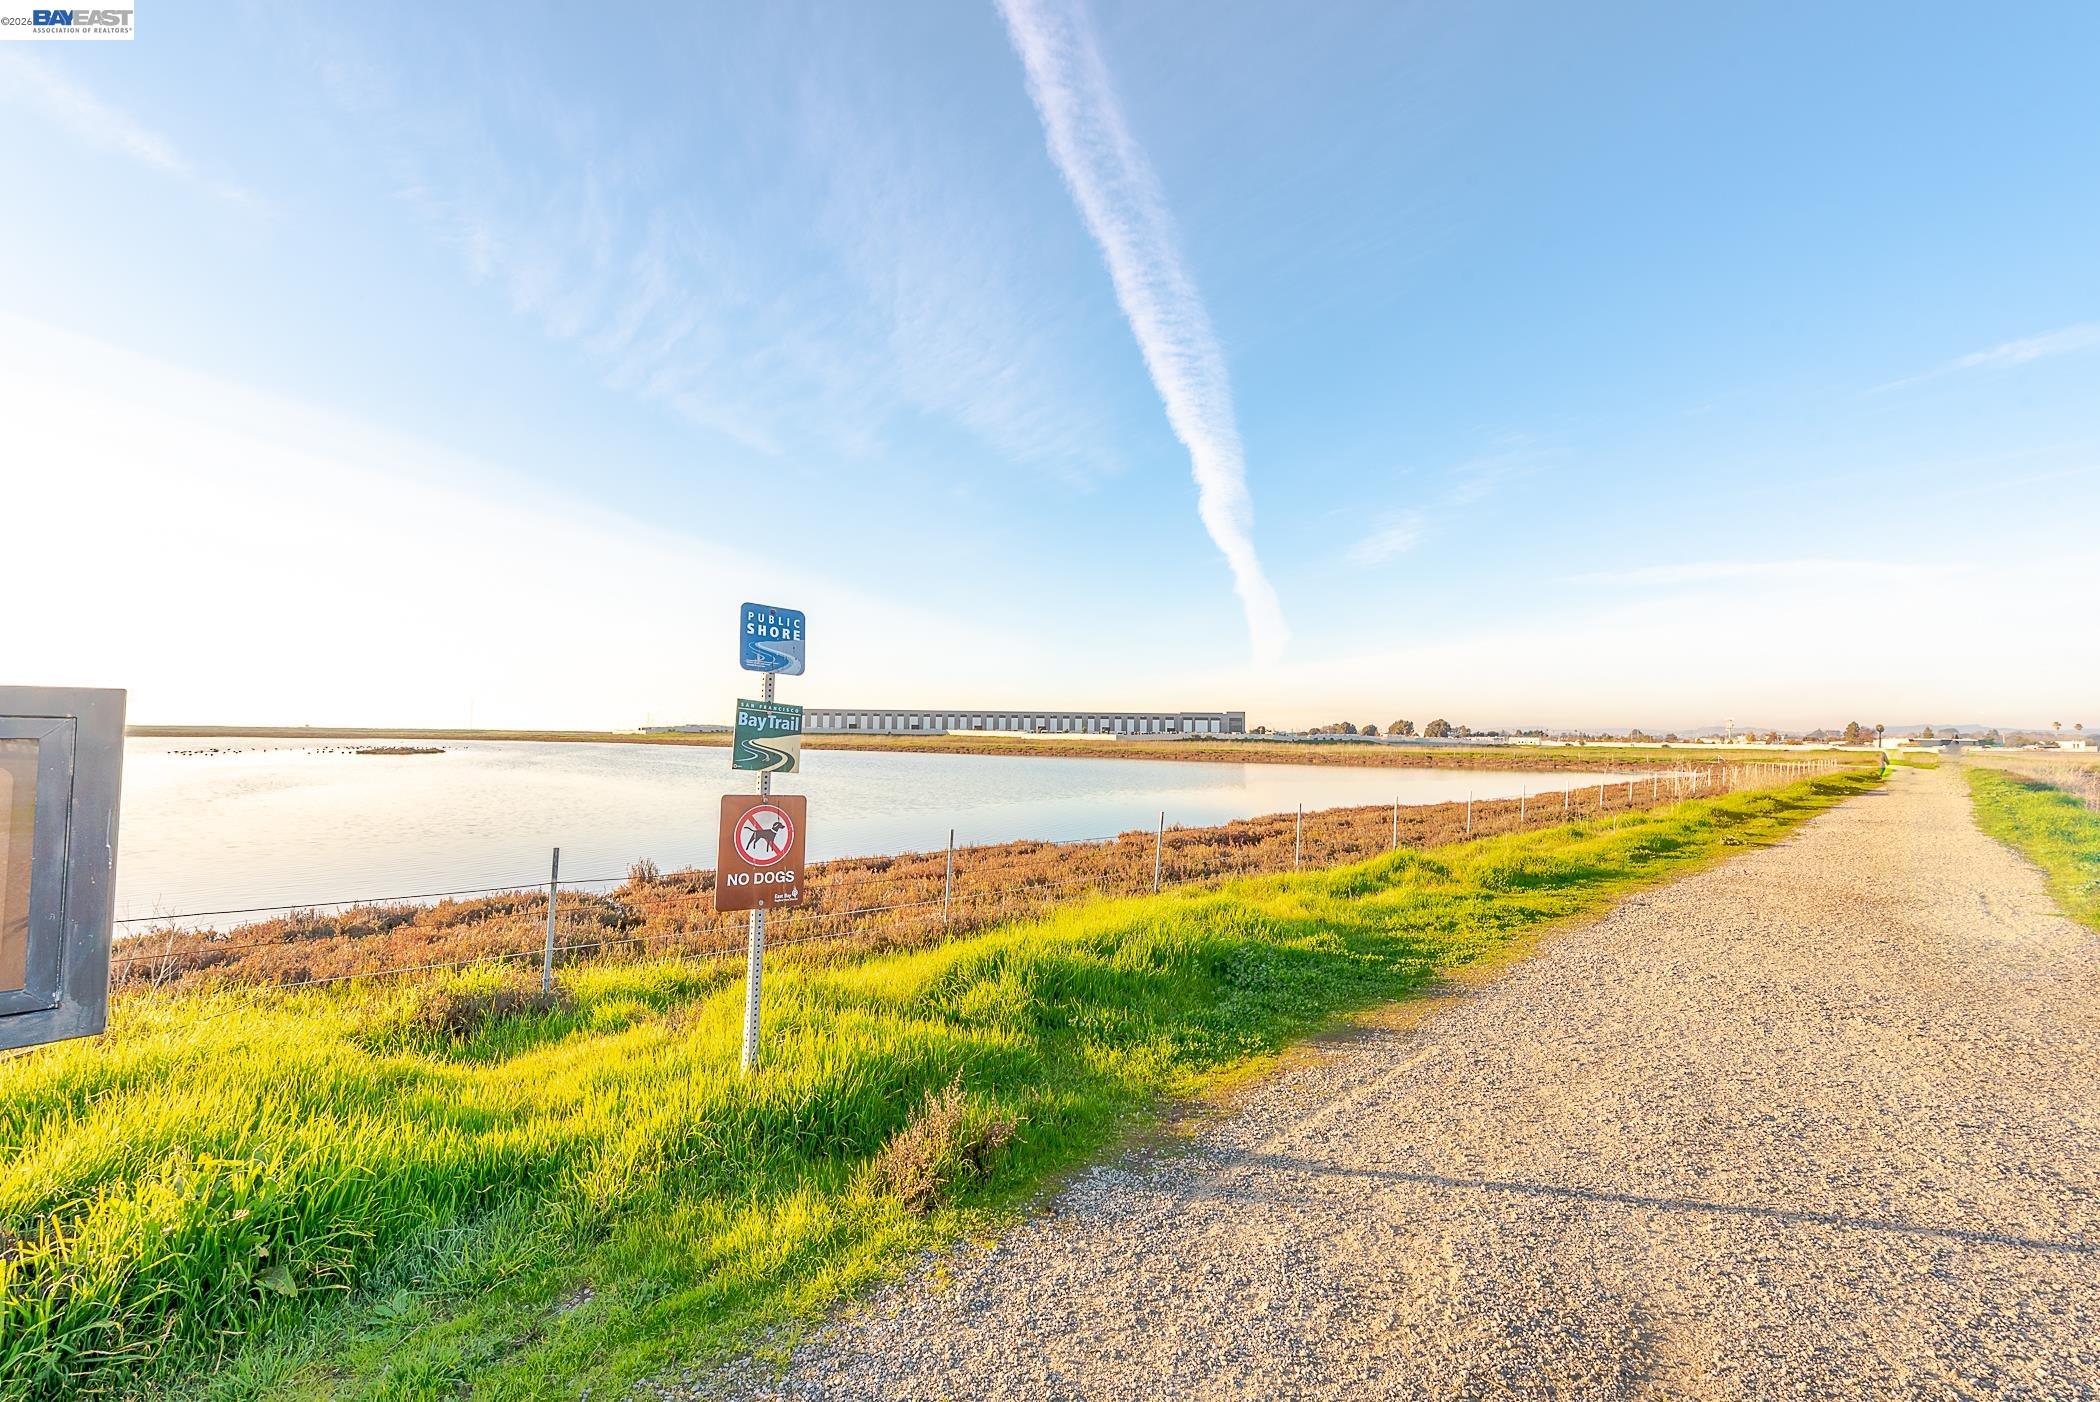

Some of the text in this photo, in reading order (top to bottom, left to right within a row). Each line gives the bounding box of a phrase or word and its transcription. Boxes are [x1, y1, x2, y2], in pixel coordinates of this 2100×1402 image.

[748, 611, 800, 628] PUBLIC
[747, 622, 800, 641] SHORE
[759, 704, 799, 713] FRANCISCO
[727, 871, 795, 886] NO DOGS
